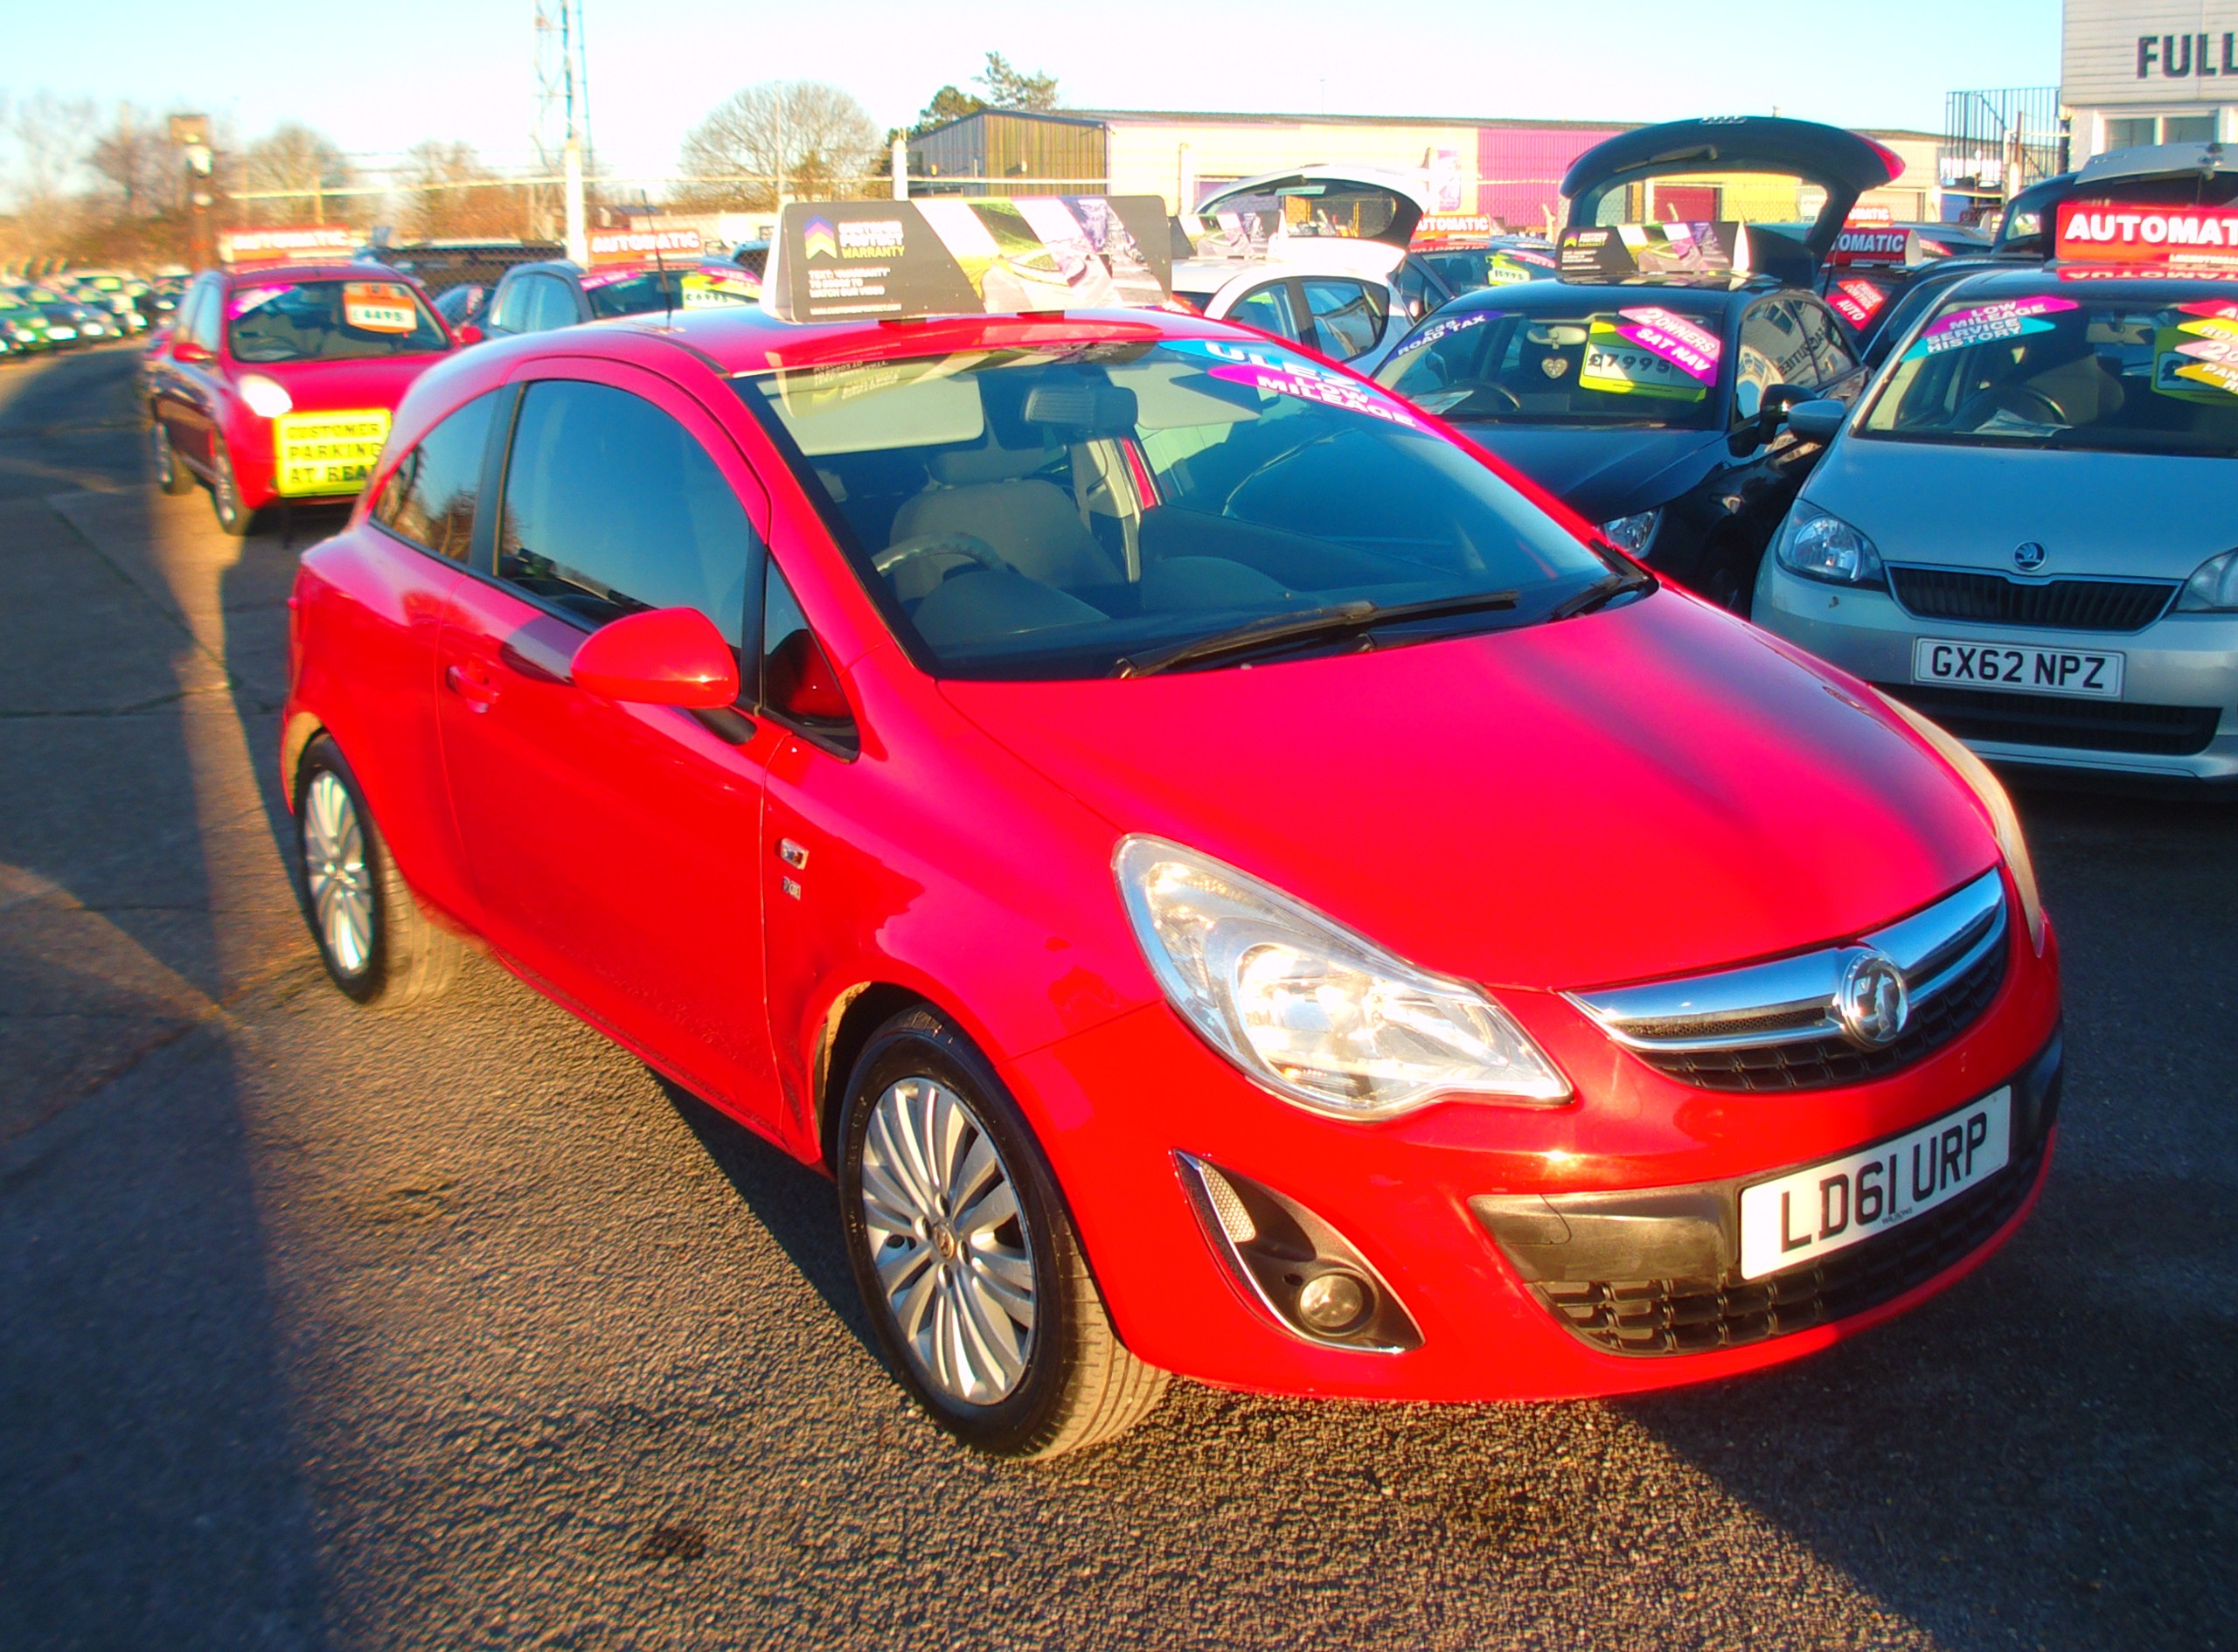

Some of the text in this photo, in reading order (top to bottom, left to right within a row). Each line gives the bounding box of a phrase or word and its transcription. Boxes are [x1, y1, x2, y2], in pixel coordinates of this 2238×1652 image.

[2137, 32, 2238, 79] FULL
[592, 231, 700, 253] AUTOMATIC
[2064, 213, 2238, 246] AUTOMAT
[841, 246, 905, 259] WARRANTY
[1836, 299, 1866, 321] AUTO
[1950, 303, 2047, 330] MILEAGE
[1970, 301, 2017, 317] LOW
[1397, 314, 1486, 356] ROAD TAX
[1926, 317, 2020, 344] SERVICE
[1927, 324, 2022, 353] HISTORY
[1636, 328, 1712, 371] SAT NAV
[1205, 341, 1361, 392] ULEZ
[1588, 353, 1671, 374] £7995
[1256, 376, 1416, 427] MILEAGE
[1294, 376, 1371, 404] LOW
[288, 423, 379, 439] CUSTOMER
[289, 442, 383, 458] PARKING
[291, 464, 372, 484] AT REA
[1931, 645, 2105, 689] GX62 NPZ
[1782, 1111, 1987, 1253] LD61 URP
